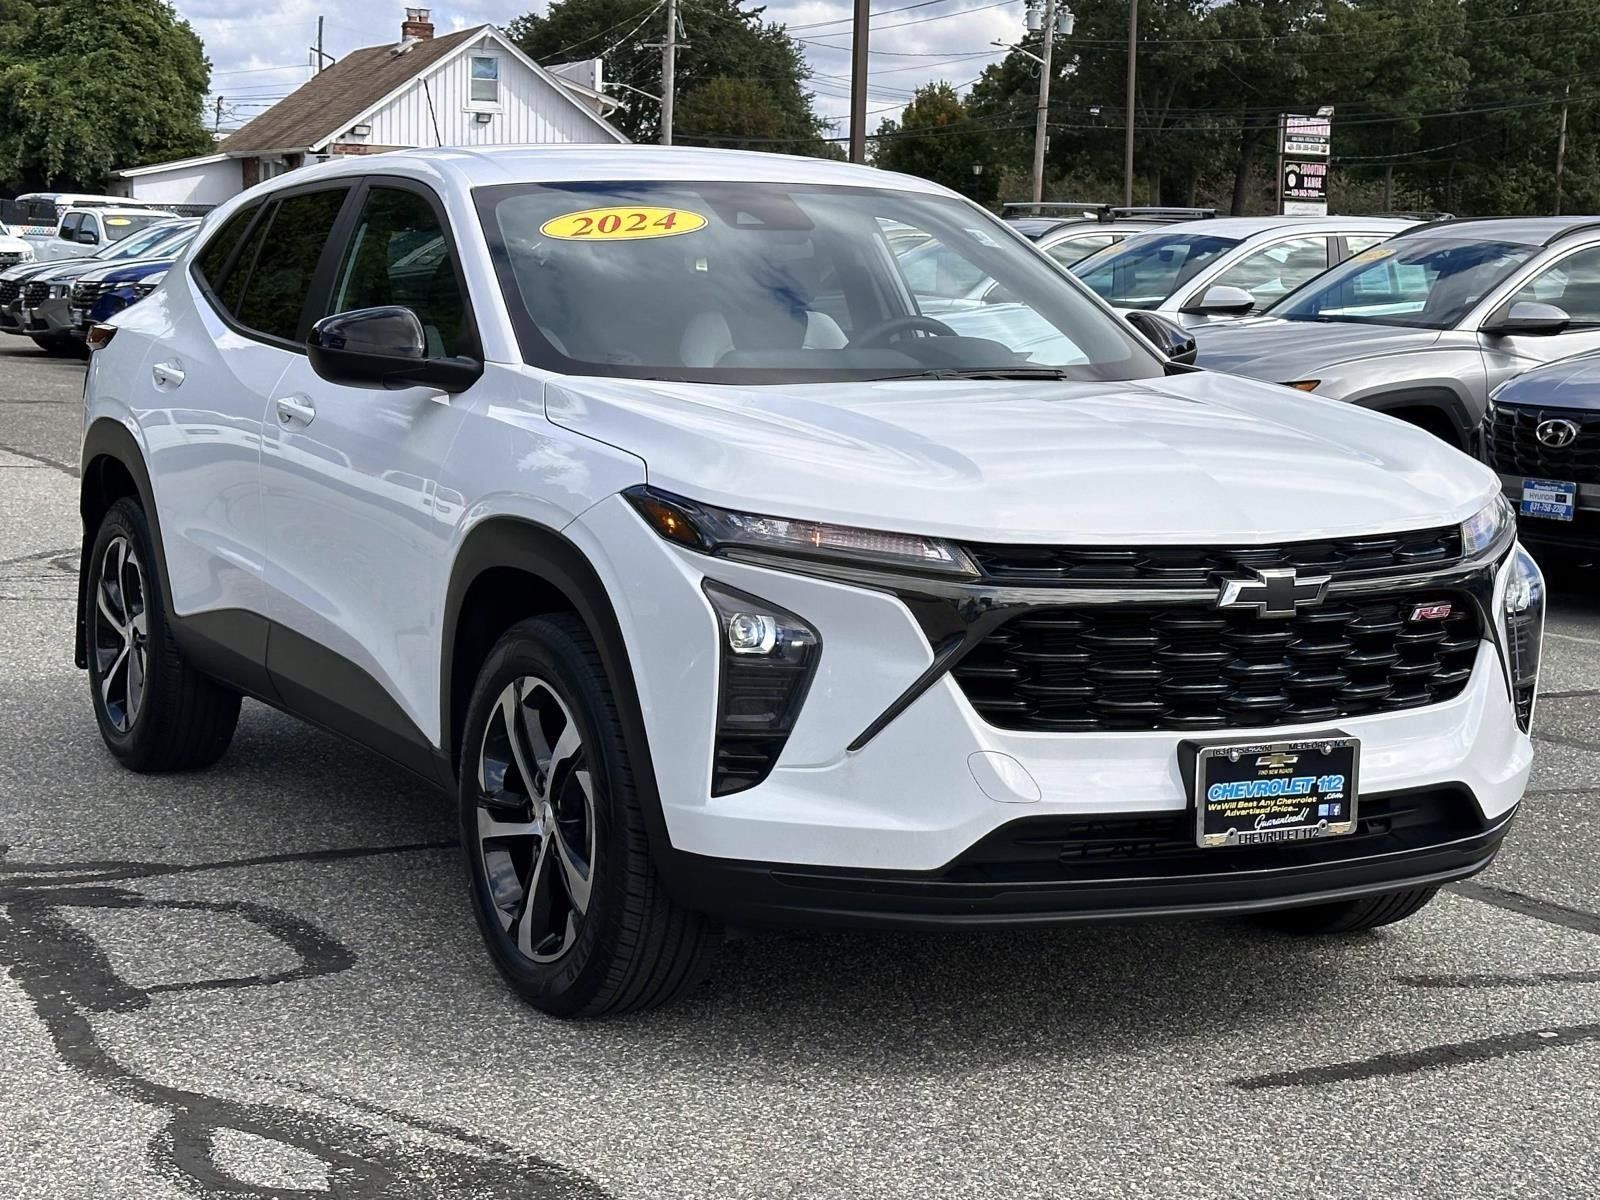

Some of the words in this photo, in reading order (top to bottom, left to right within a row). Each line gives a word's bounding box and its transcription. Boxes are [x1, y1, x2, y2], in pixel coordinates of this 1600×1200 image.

[1304, 176, 1322, 188] RANGE
[570, 212, 677, 237] 2024
[1410, 604, 1452, 620] RS
[1208, 776, 1316, 801] CHEVROLET
[1317, 774, 1344, 793] 112
[1237, 800, 1257, 808] Beat
[1258, 799, 1276, 807] Any
[1276, 796, 1317, 805] Chevrolet
[1224, 808, 1270, 817] Advertised
[1239, 830, 1299, 845] CHEVROLET
[1301, 827, 1319, 839] 112
